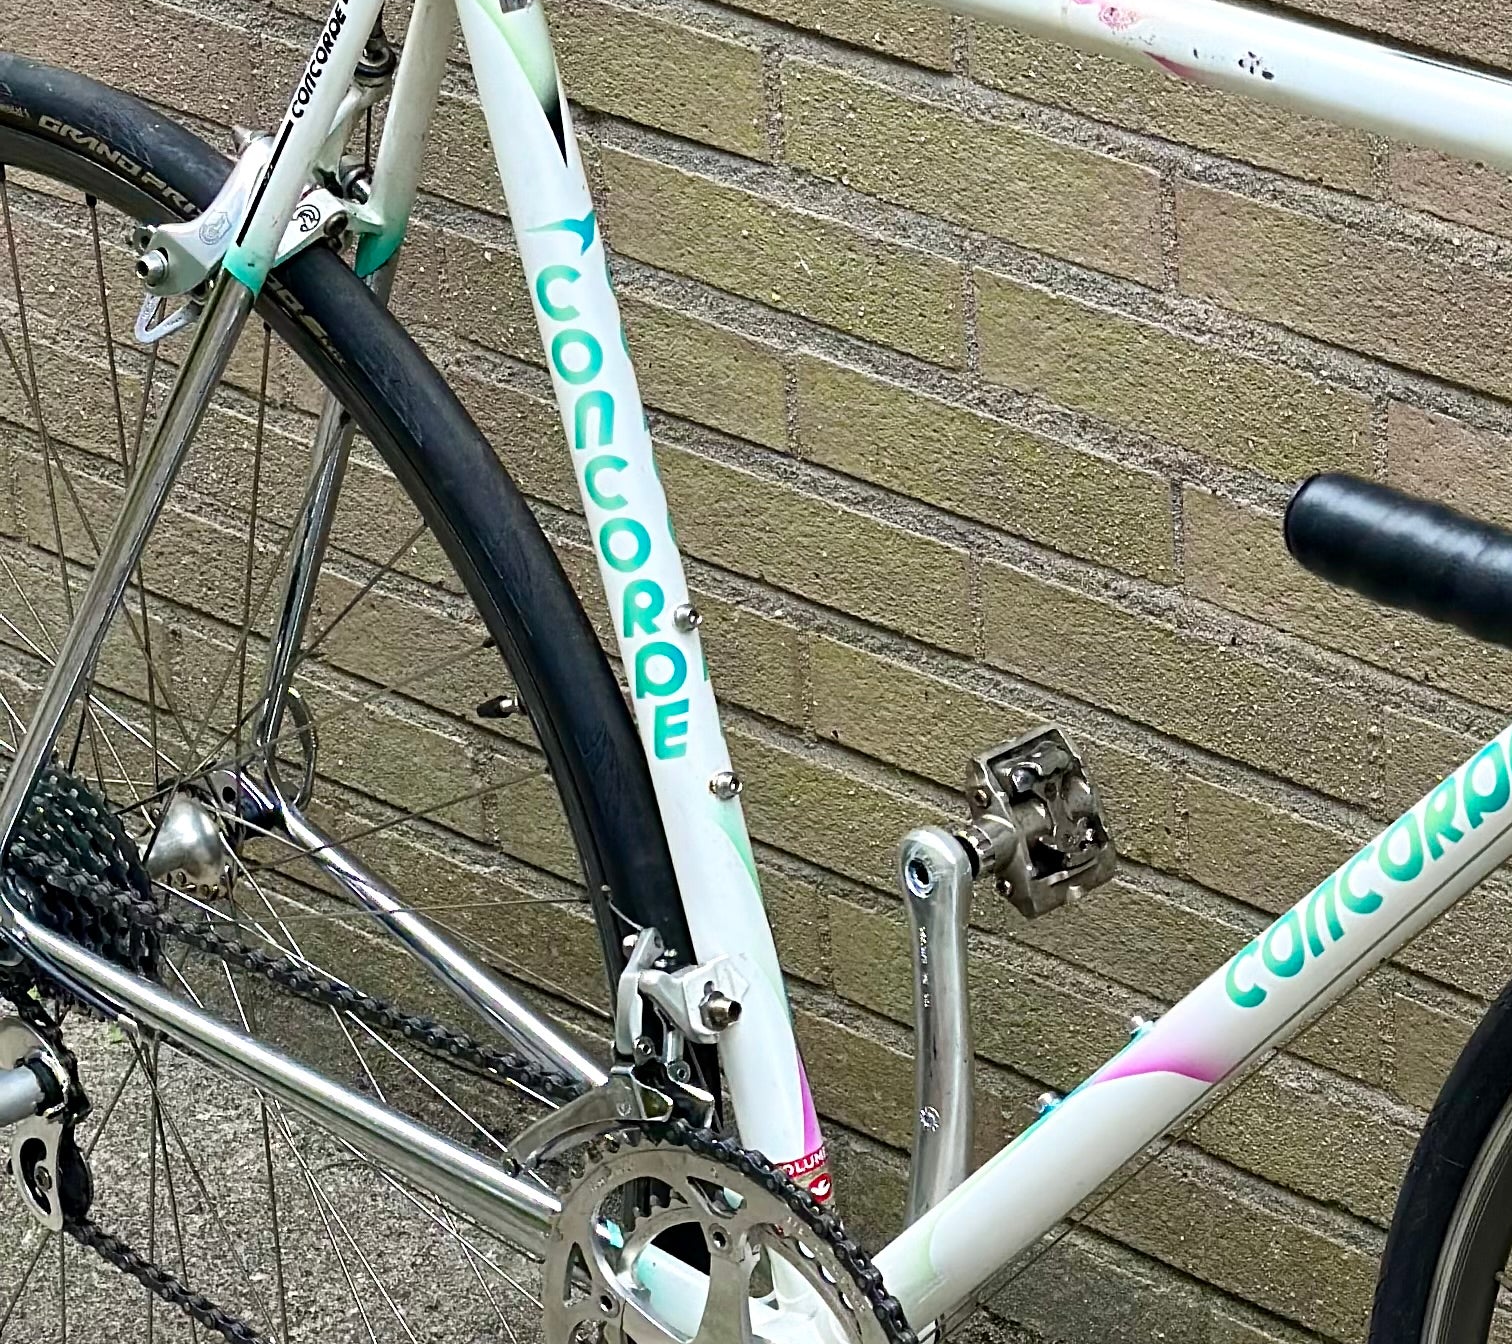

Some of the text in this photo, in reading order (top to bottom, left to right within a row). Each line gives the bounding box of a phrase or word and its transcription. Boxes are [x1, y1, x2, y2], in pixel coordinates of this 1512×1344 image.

[291, 2, 347, 118] CONCORDE
[38, 114, 142, 177] GRAND
[142, 171, 202, 216] PRI
[534, 264, 690, 761] CONCORDE
